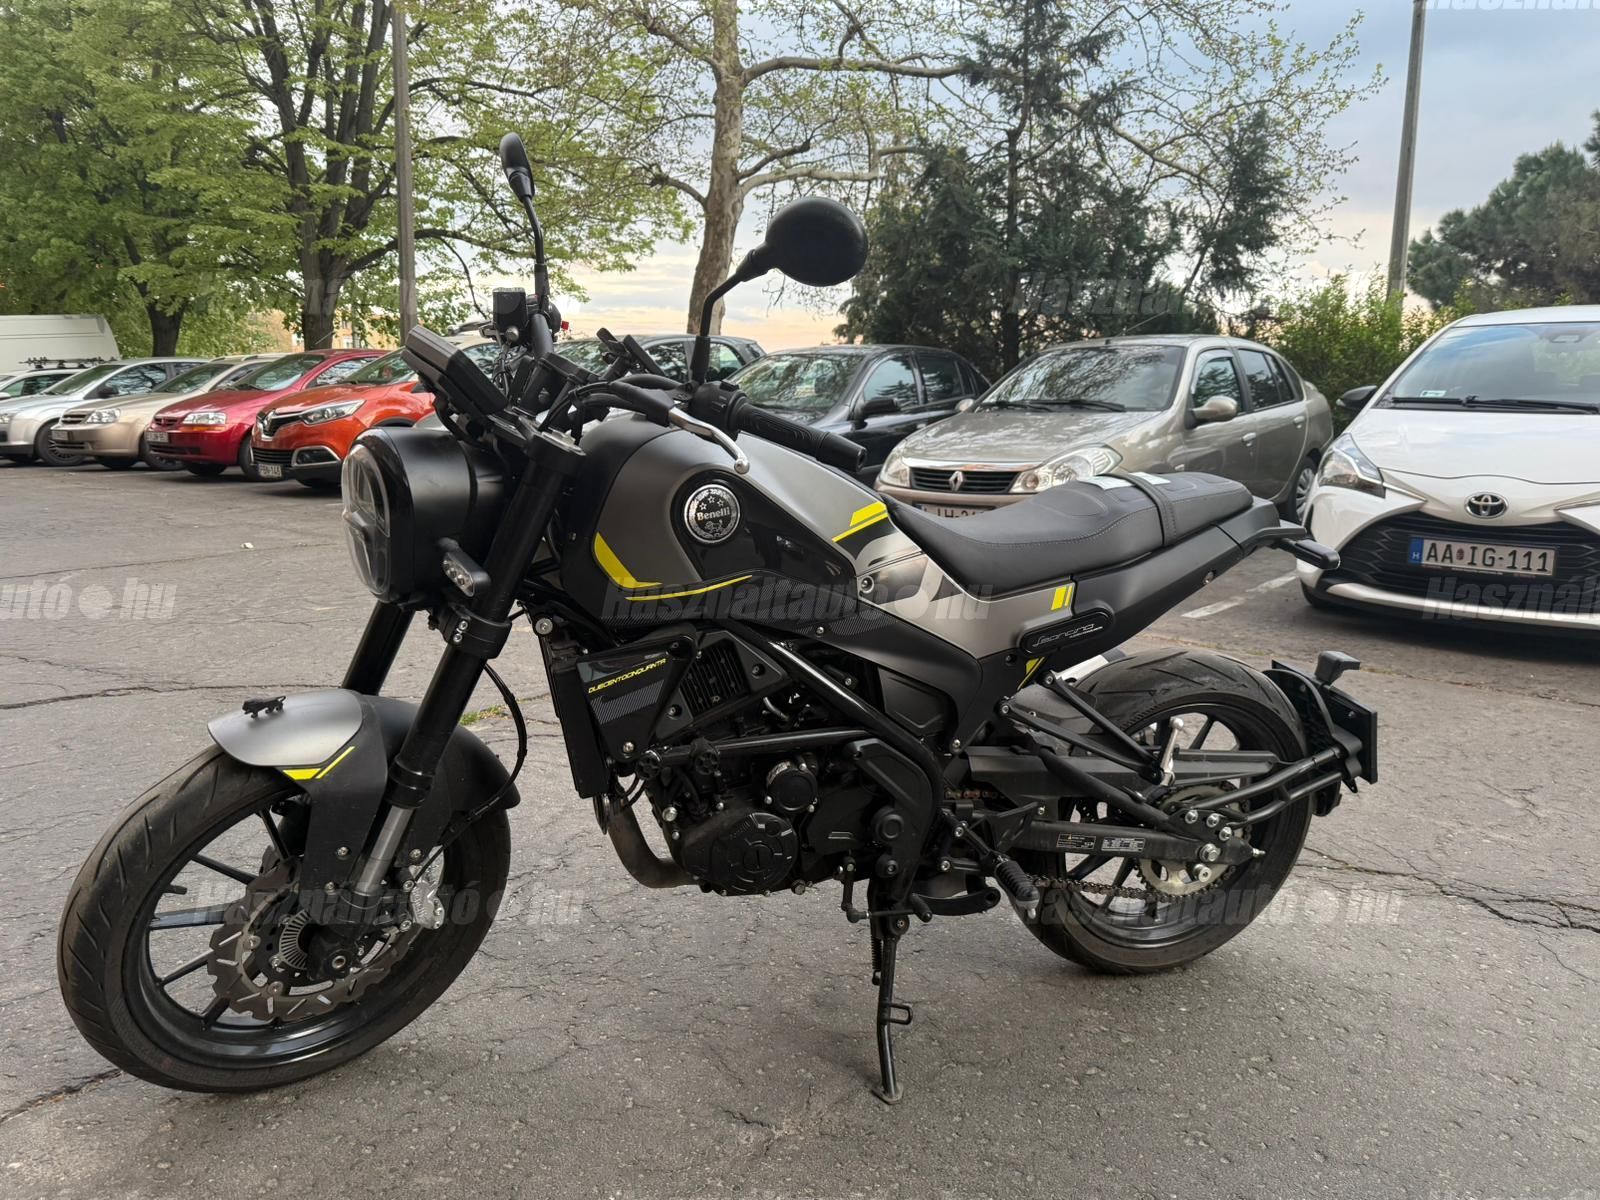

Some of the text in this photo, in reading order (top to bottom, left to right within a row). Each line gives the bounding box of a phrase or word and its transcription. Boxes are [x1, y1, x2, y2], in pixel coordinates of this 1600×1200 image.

[697, 507, 730, 521] Benelli
[1426, 543, 1454, 563] AA
[1467, 545, 1549, 572] IG-111
